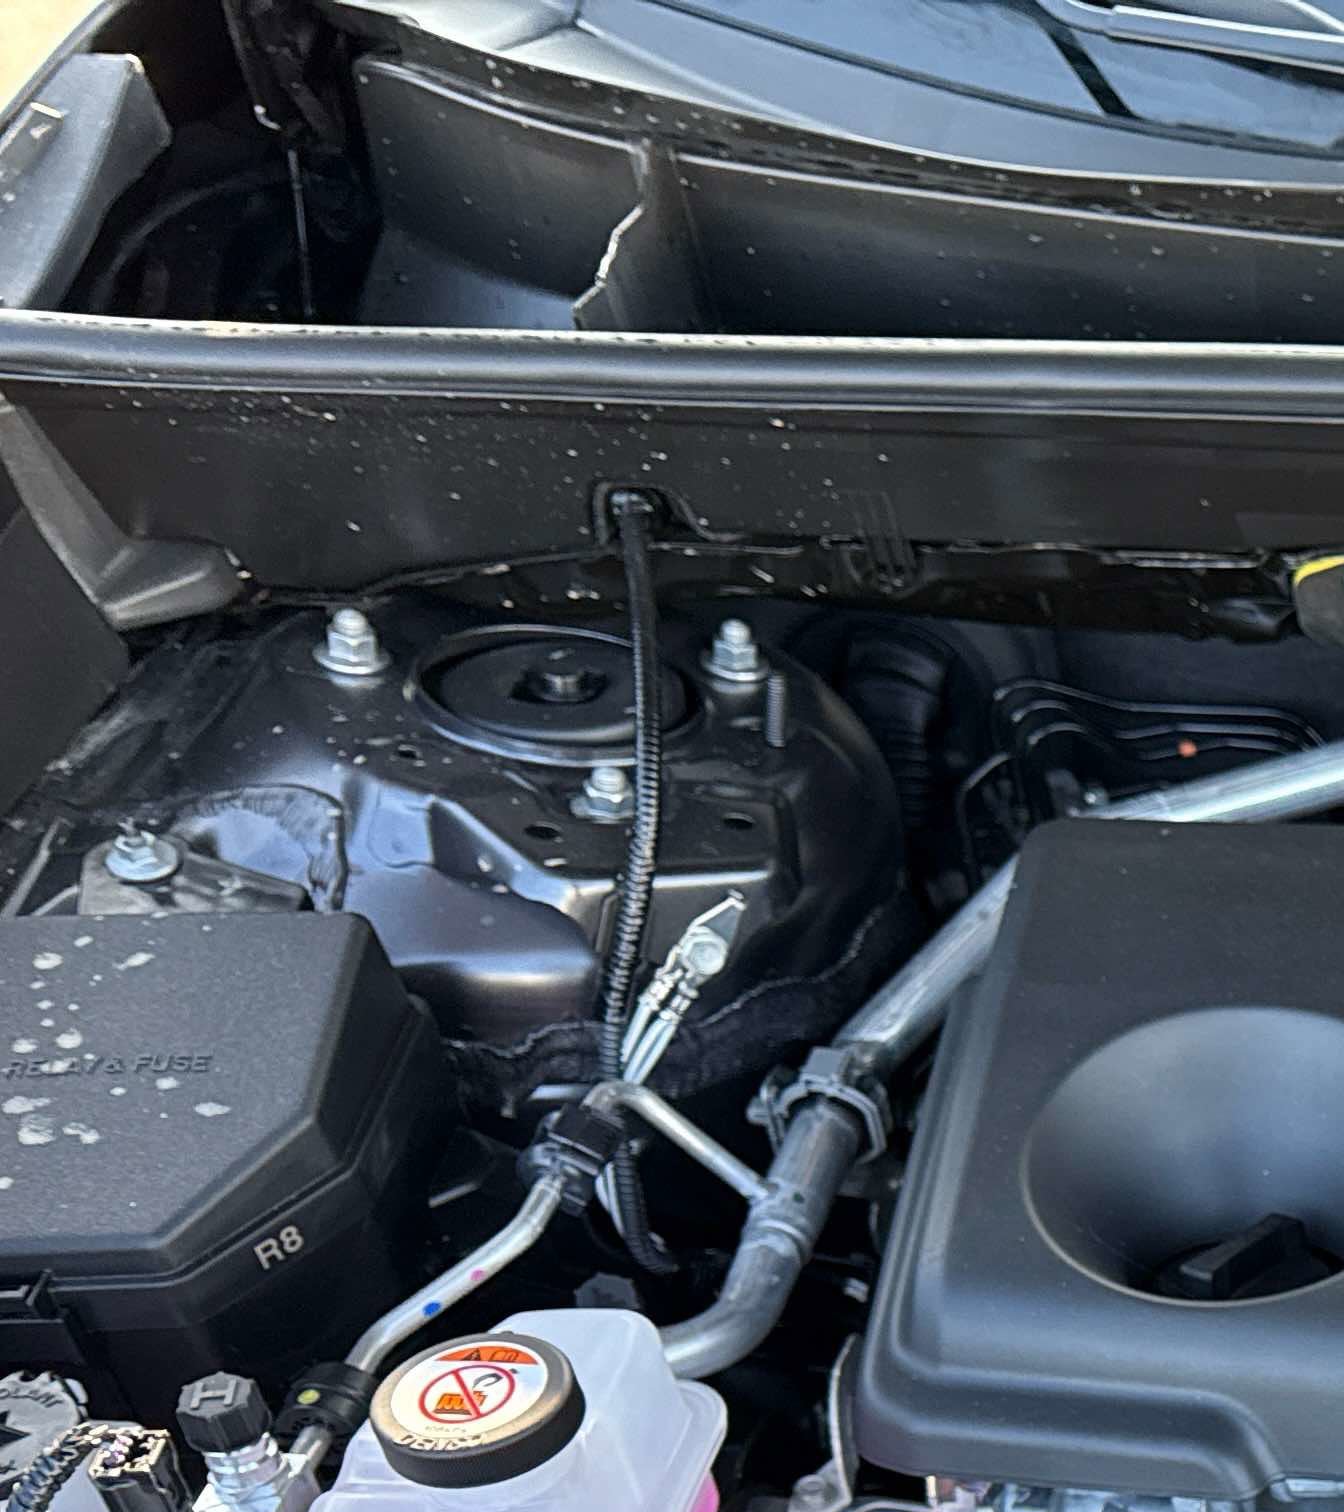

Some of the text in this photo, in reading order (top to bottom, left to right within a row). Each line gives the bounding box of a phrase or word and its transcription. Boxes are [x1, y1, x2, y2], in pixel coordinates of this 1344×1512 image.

[104, 1057, 124, 1075] &
[134, 1054, 214, 1074] FUSE
[253, 1224, 304, 1271] R8
